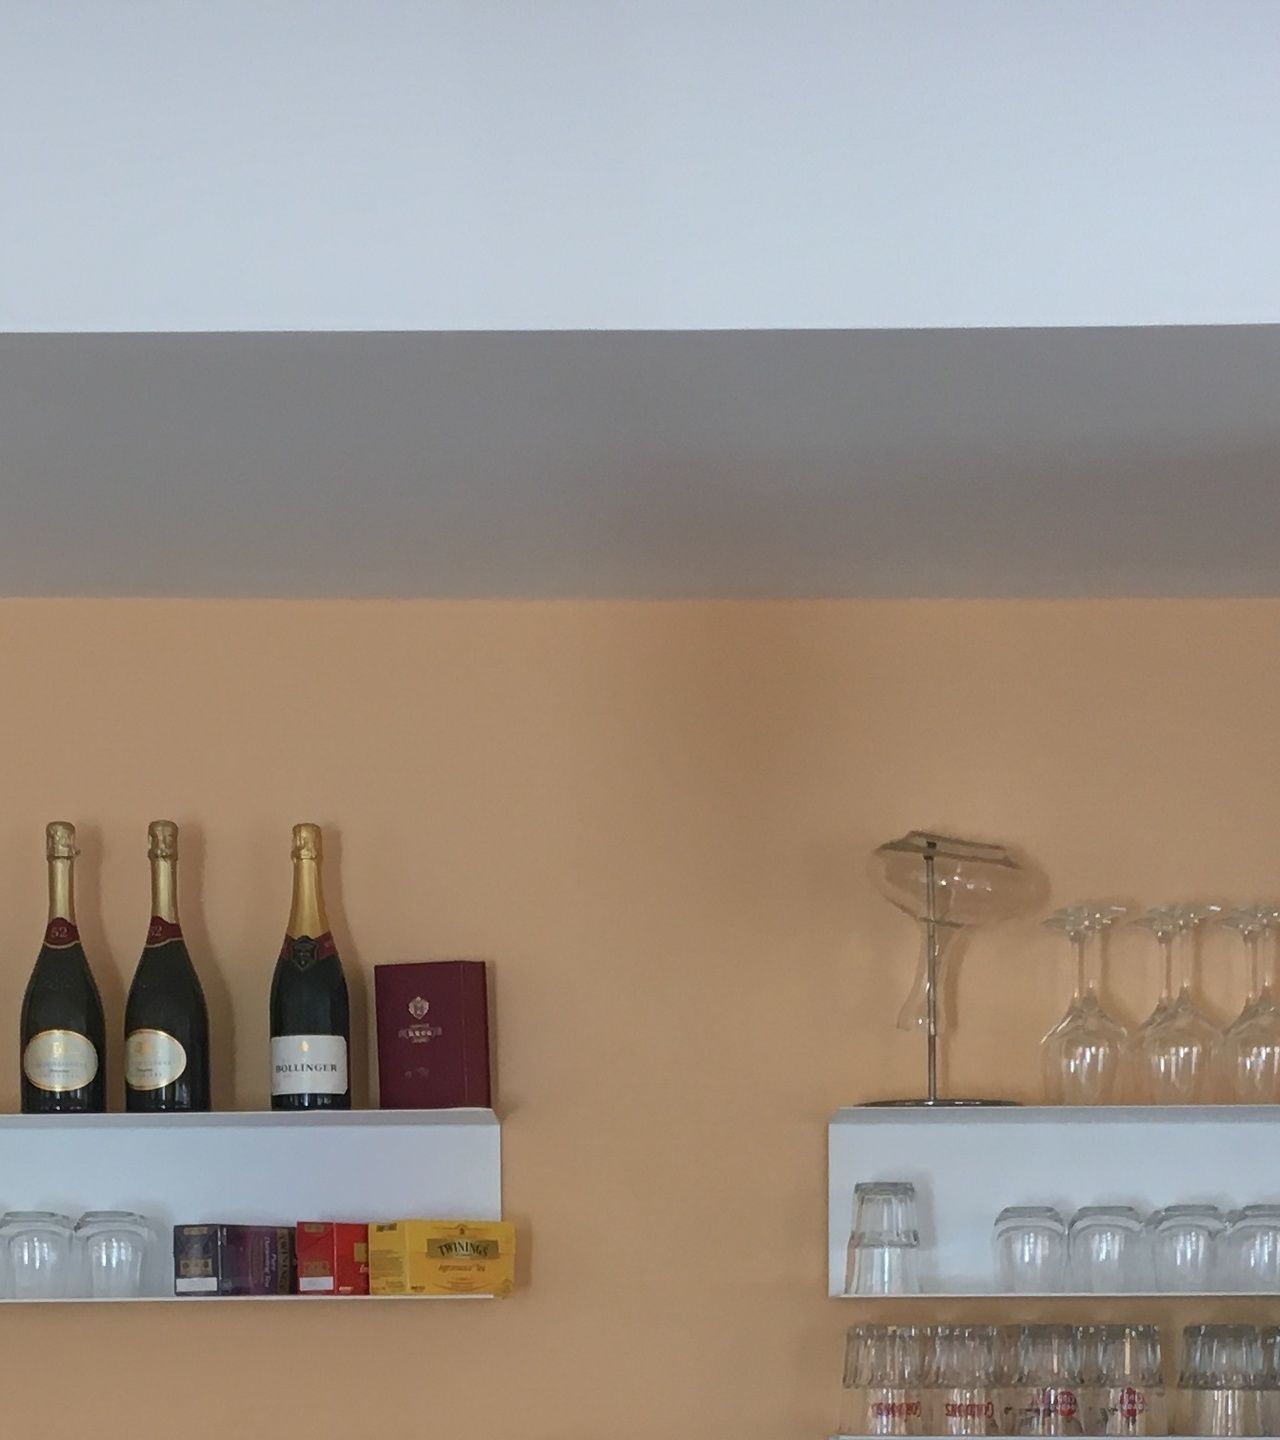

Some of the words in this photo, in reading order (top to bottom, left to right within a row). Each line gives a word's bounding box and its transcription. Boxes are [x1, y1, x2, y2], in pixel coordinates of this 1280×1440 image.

[50, 926, 68, 938] 52
[275, 1063, 338, 1073] BOLLINGER
[437, 1240, 490, 1257] TWININGS
